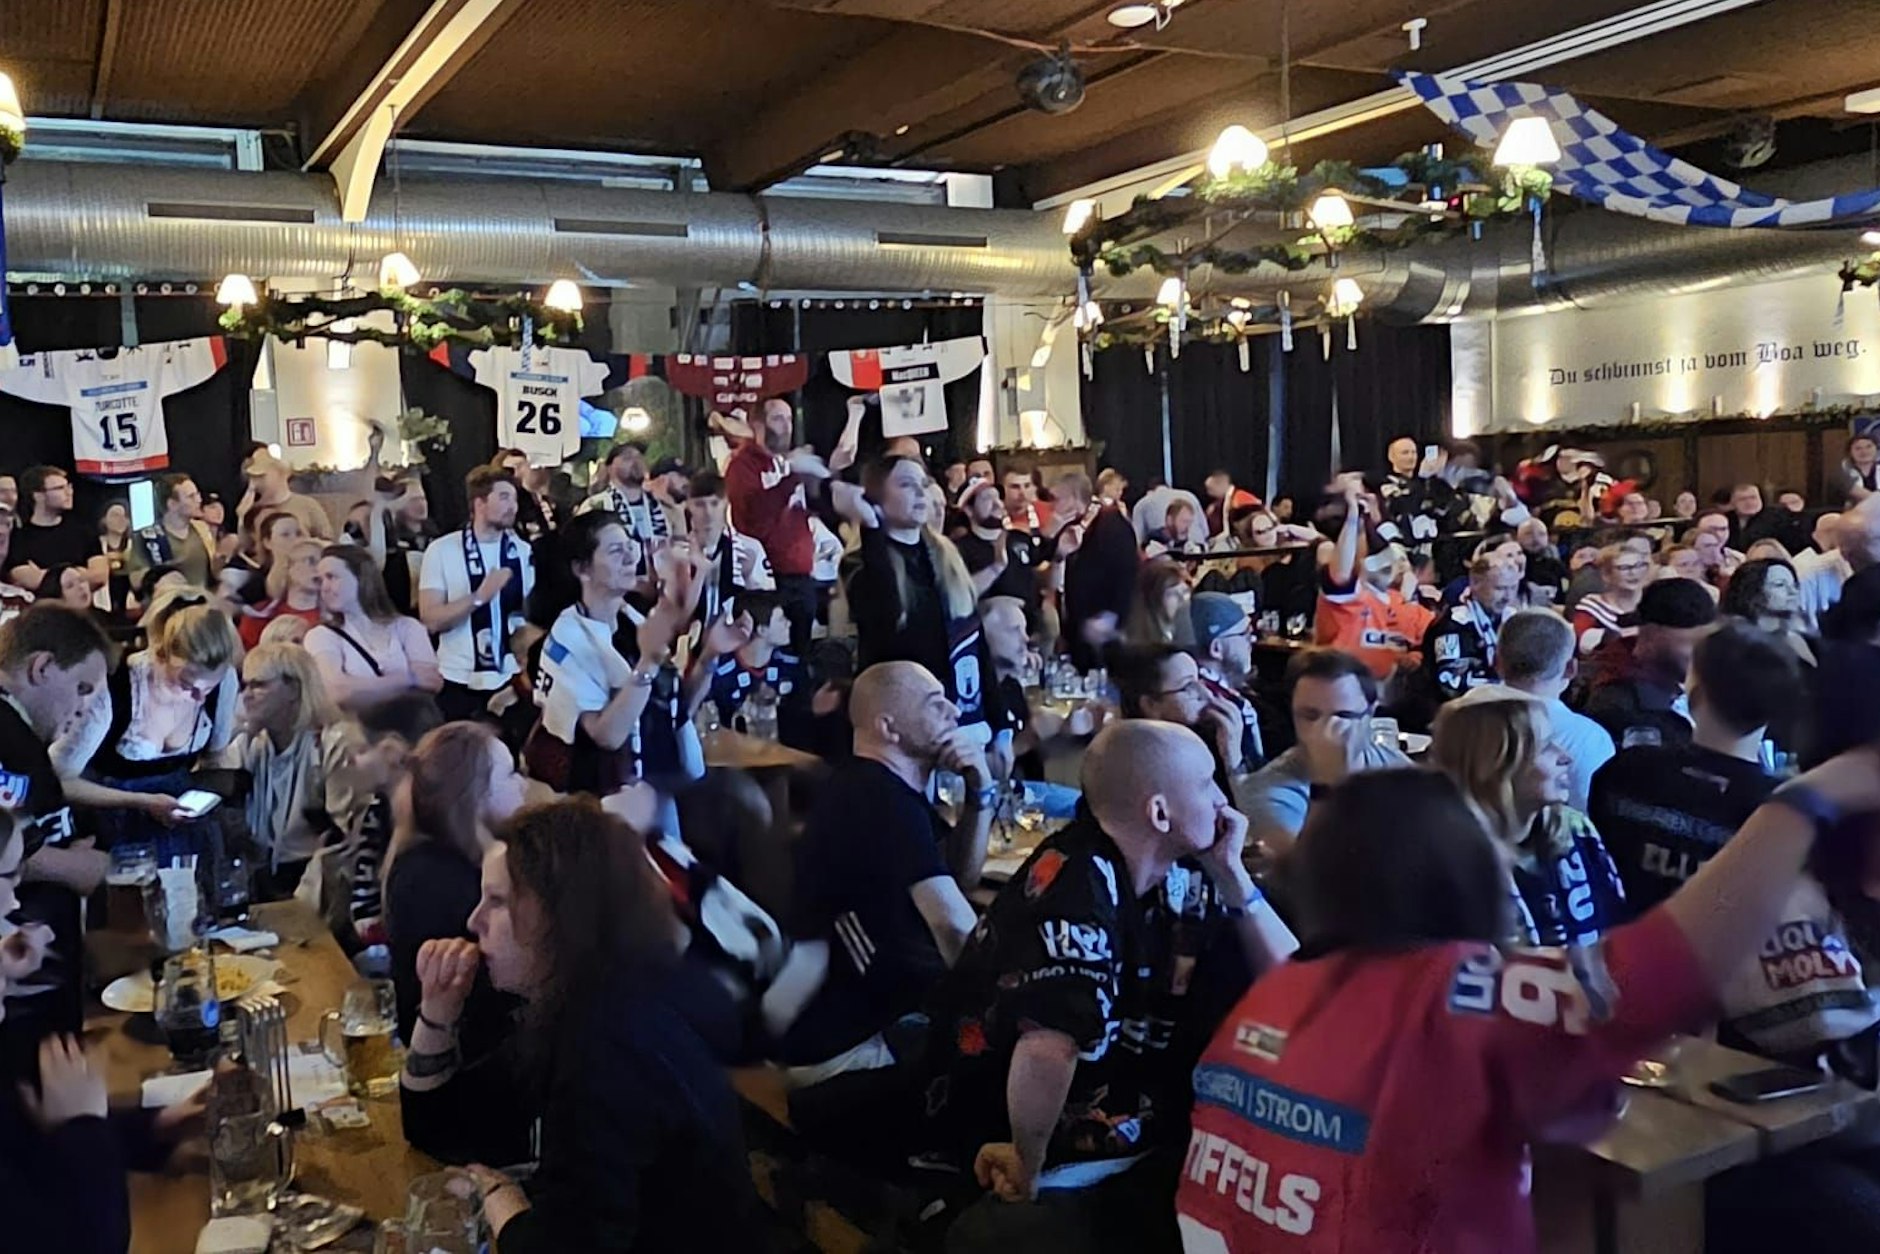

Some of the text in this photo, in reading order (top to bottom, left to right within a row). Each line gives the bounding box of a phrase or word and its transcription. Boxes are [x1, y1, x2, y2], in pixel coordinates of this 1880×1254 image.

[1549, 368, 1577, 385] Du
[1704, 350, 1748, 370] vom
[99, 412, 141, 452] 15
[516, 400, 562, 436] 26
[1254, 1088, 1342, 1142] STROM
